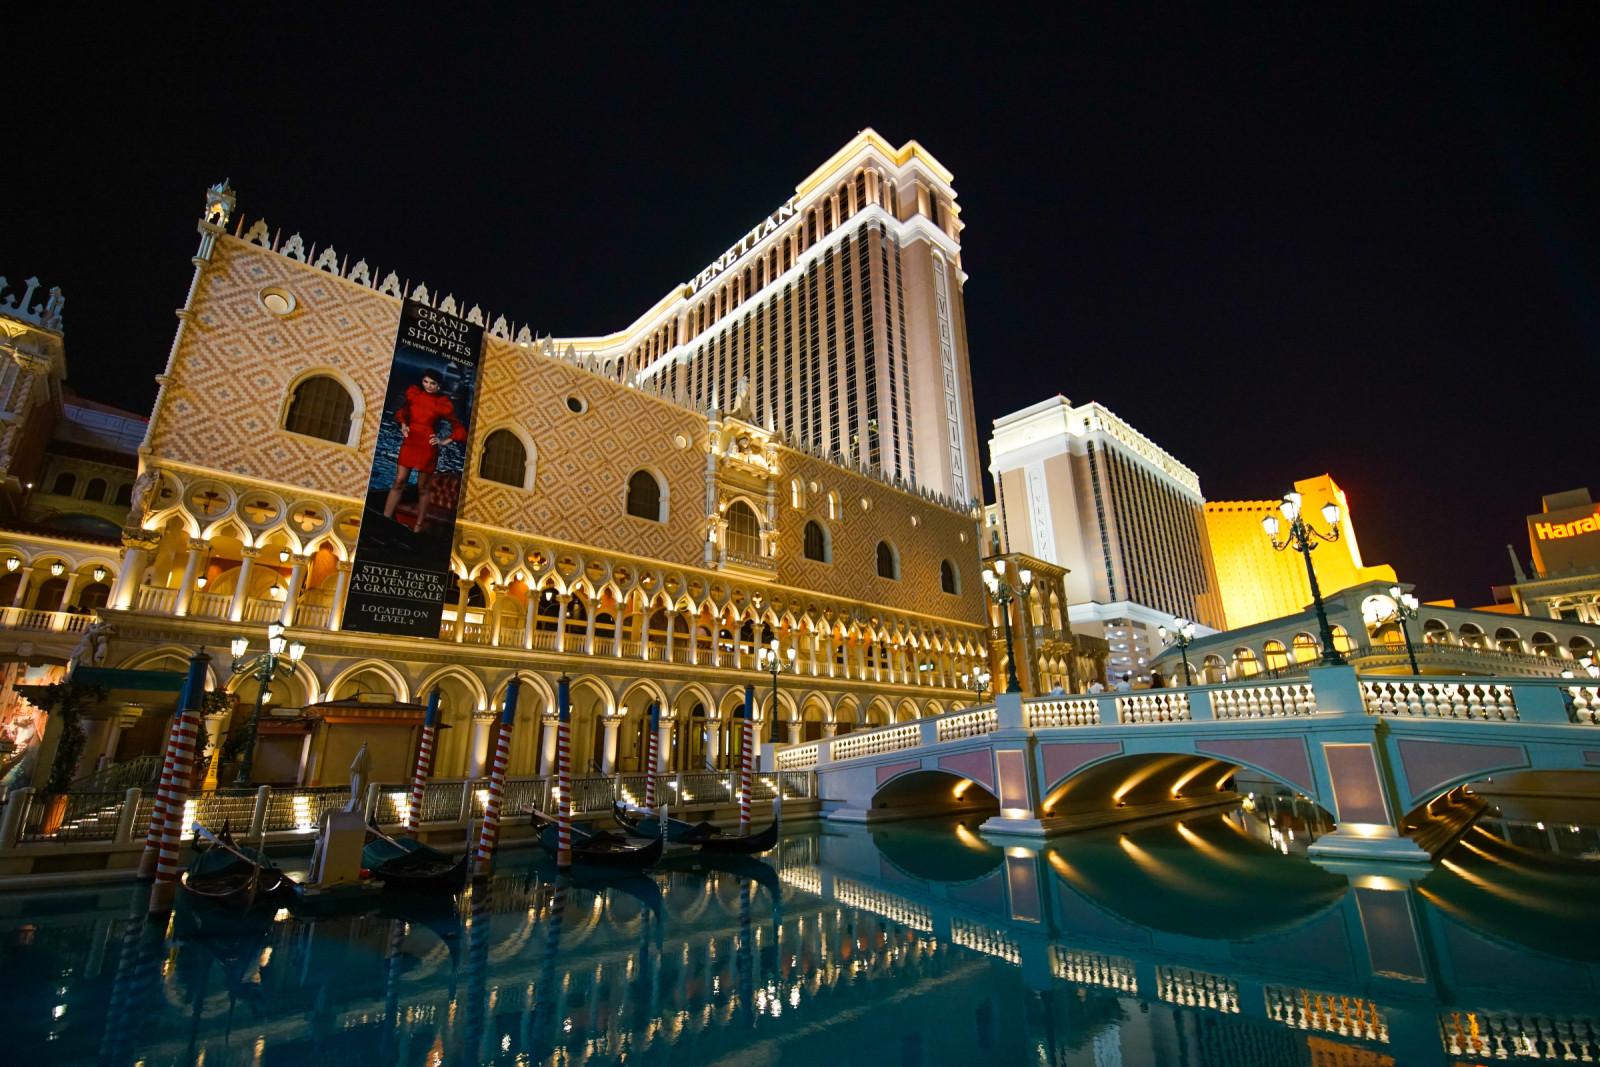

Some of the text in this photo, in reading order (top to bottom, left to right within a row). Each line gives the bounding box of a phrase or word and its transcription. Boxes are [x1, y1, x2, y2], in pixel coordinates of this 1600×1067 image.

[688, 197, 795, 293] VENETIAN
[418, 308, 469, 333] GRAND
[418, 320, 466, 343] CANAL
[402, 338, 474, 367] THE VENETIAN THE PALAZZO
[408, 327, 471, 356] SHOPPES
[939, 298, 963, 498] VENETIAN
[352, 573, 445, 592] AND VENICE ON
[362, 565, 439, 584] STYLE, TASTE
[352, 582, 442, 601] A GRAND SCALE
[361, 604, 429, 619] LOCATED ON
[373, 614, 406, 624] LEVEL
